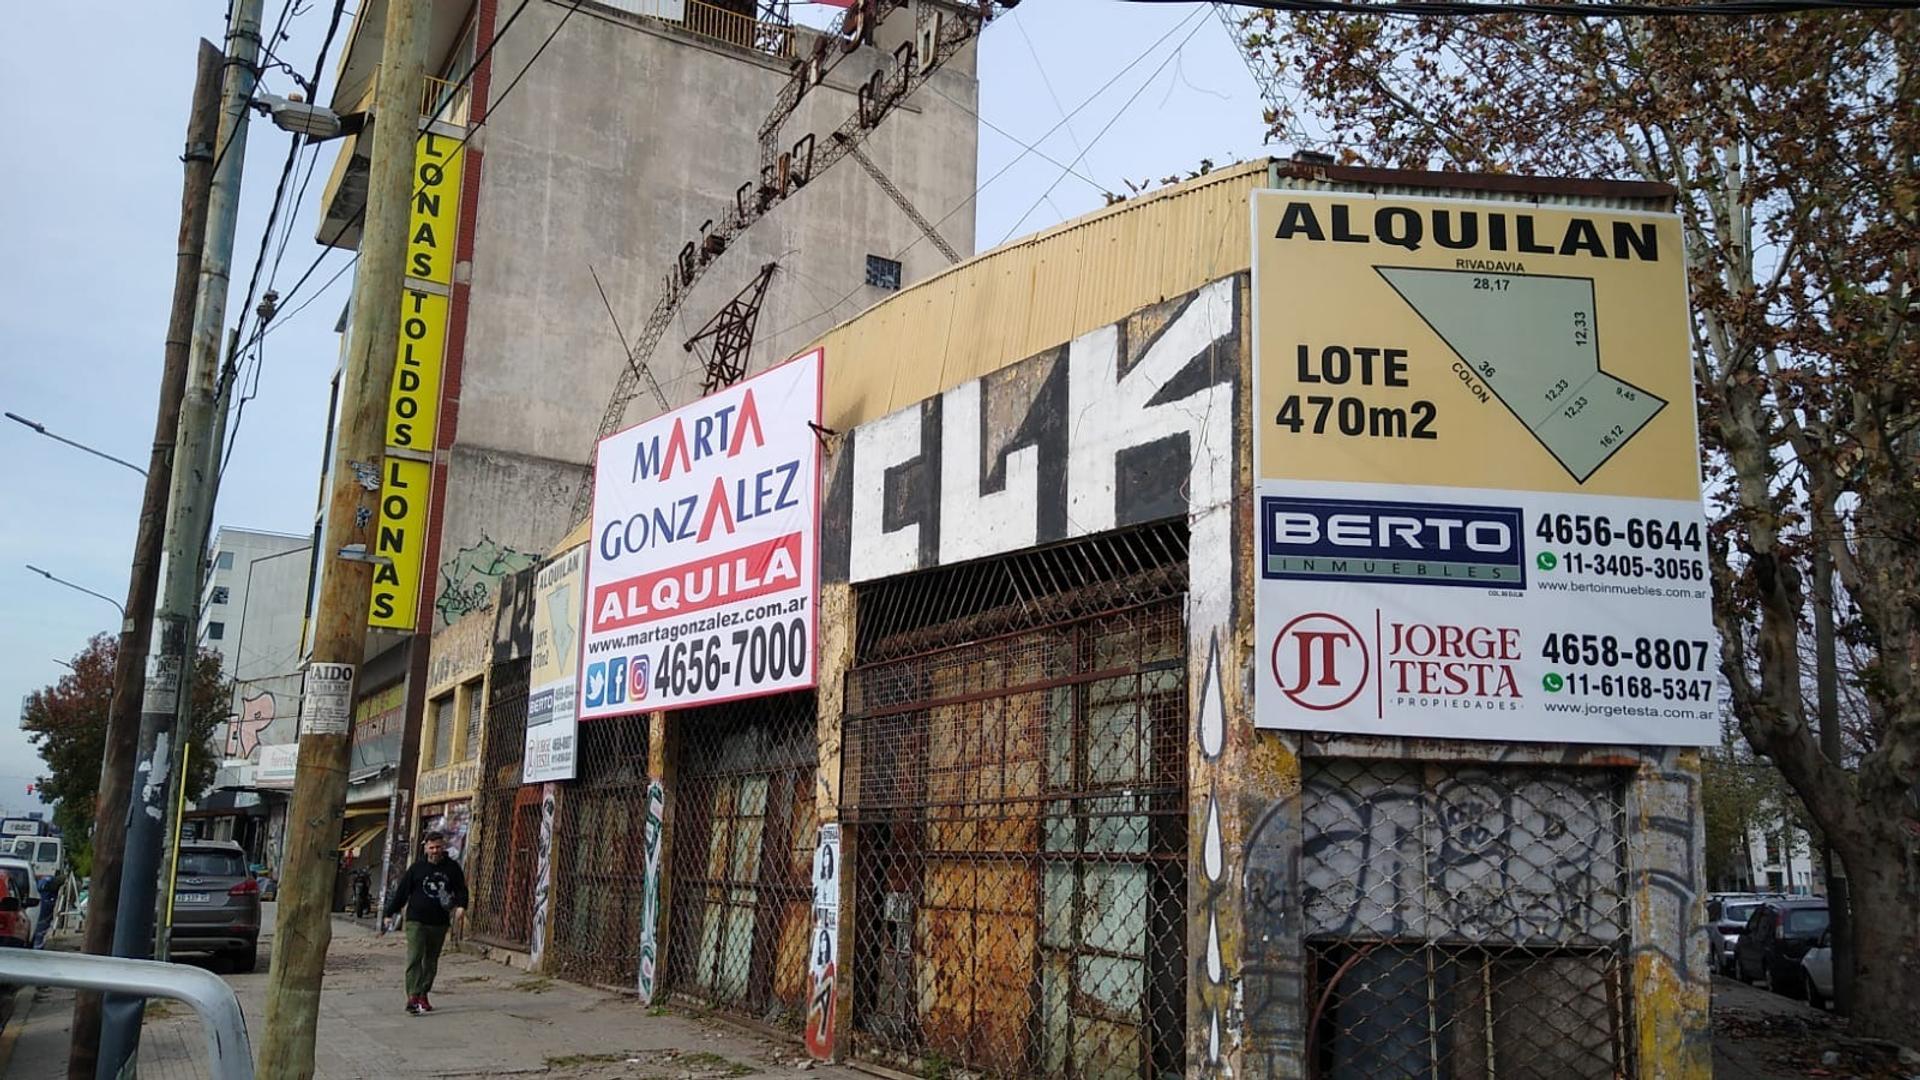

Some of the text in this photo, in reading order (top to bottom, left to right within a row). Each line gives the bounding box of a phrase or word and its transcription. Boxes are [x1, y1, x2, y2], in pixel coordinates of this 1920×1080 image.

[413, 133, 443, 277] LONAS
[1275, 202, 1659, 261] ALQUILAN
[1456, 258, 1525, 273] RIVADAVIA
[1473, 278, 1510, 292] 28,17
[1574, 311, 1588, 347] 12,33
[394, 291, 427, 446] TOLDOS
[1297, 344, 1409, 388] LOTE
[1452, 362, 1490, 404] COLON
[1479, 361, 1496, 378] 36
[1545, 379, 1569, 402] 12,33
[1564, 396, 1588, 419] 12,33
[632, 387, 765, 484] MARTA
[1276, 395, 1438, 440] 470m2
[1600, 424, 1624, 449] 16,12
[600, 459, 800, 561] GONZALEZ
[373, 463, 408, 619] LONAS
[1275, 512, 1511, 553] BERTO
[1536, 513, 1702, 552] 4656-6644
[598, 546, 798, 625] ALQUILA
[1282, 559, 1502, 579] INMUEBLES
[1563, 552, 1704, 581] 11-3405-3056
[1538, 581, 1706, 599] www.bertoinmuebles.com.ar
[588, 596, 808, 654] www.martagonzalez.com.ar
[1389, 623, 1521, 660] JORGE
[654, 617, 807, 698] 4656-7000
[1542, 633, 1708, 671] 4658-8807
[1390, 660, 1523, 698] TESTA
[1566, 673, 1712, 702] 11-6168-5347
[1544, 702, 1713, 720] www.jorgetesta.com.ar
